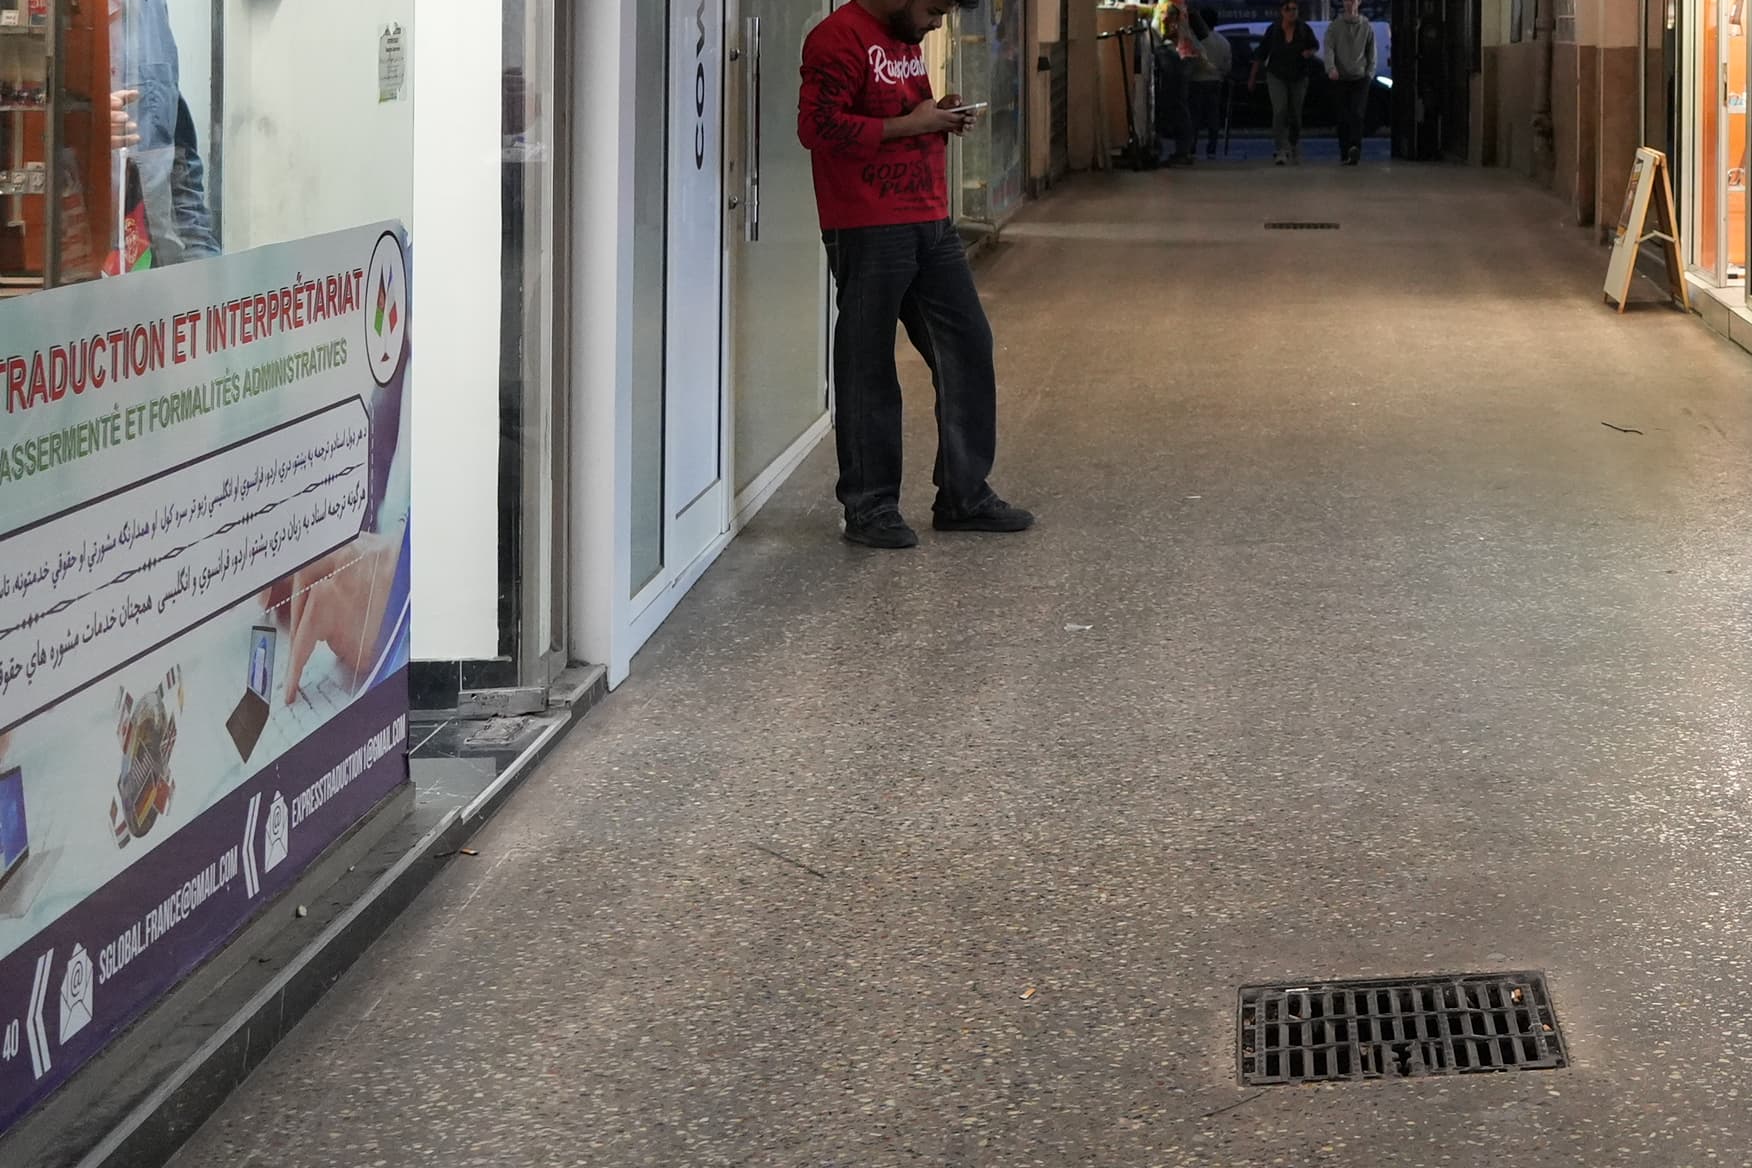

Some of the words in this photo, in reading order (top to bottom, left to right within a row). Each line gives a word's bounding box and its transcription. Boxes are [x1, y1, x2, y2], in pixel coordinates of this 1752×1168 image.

[172, 309, 201, 364] ET
[206, 268, 363, 354] INTERPRÉTARIAT
[0, 402, 122, 487] ASSERMENTÉ
[125, 402, 146, 441] ET
[149, 368, 241, 433] FORMALITÉS
[243, 337, 347, 399] ADMINISTRATIVES
[291, 713, 407, 830] EXPRESSTRADUCTION1@GMAIL.COM
[98, 844, 238, 985] SGLOBAL.FRANCE@GMAIL.COM
